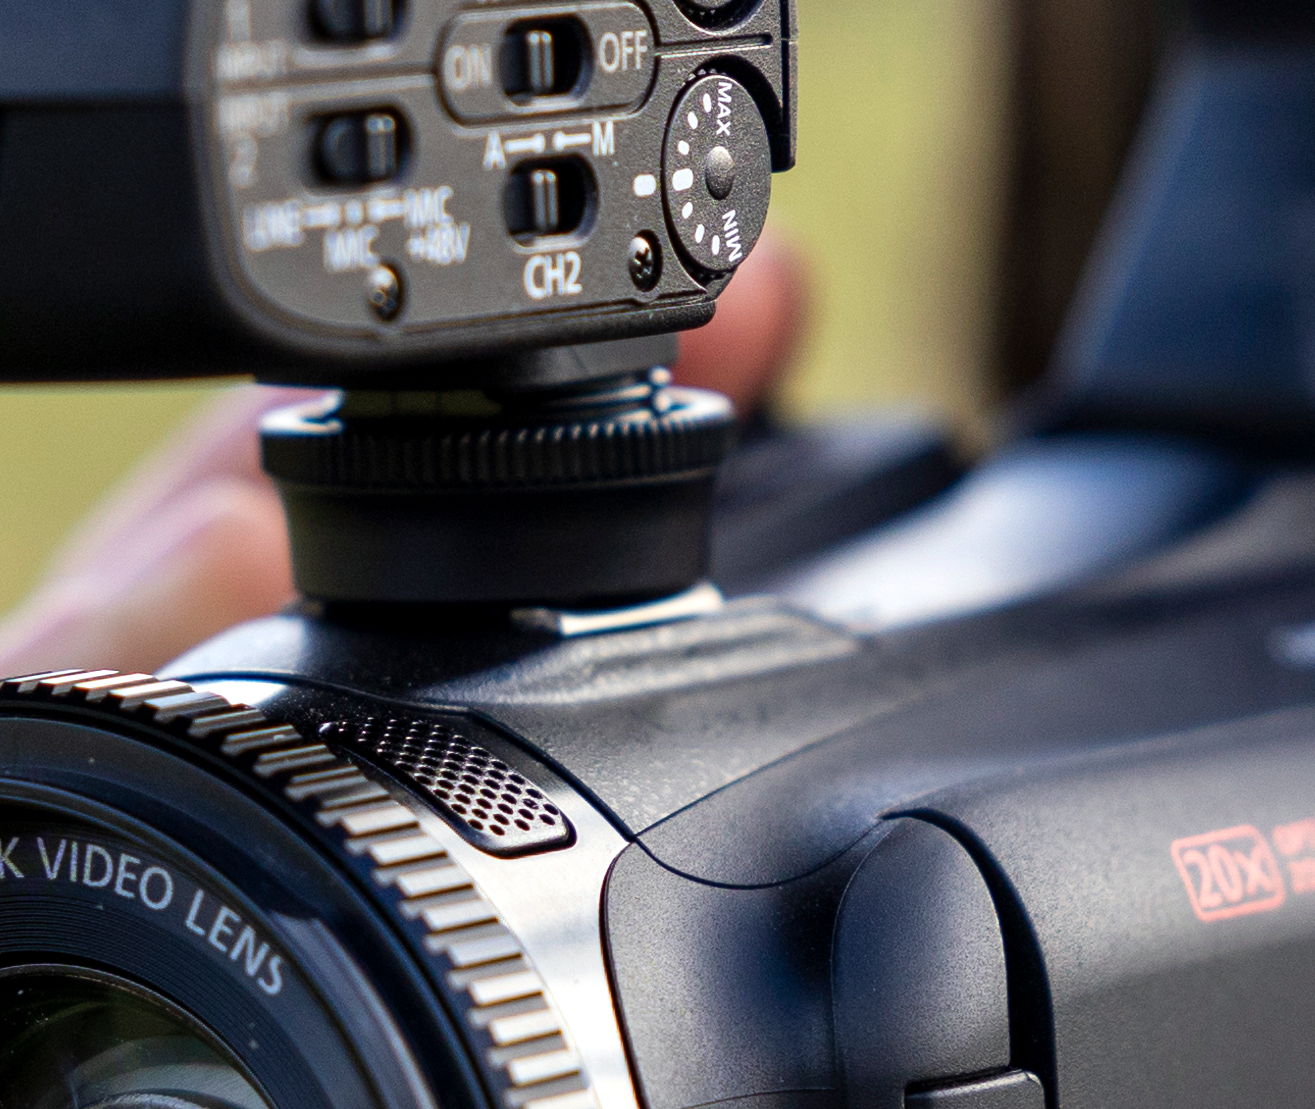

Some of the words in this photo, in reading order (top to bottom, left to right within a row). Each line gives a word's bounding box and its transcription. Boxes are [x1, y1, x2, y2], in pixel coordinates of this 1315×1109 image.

[444, 43, 492, 92] ON
[599, 30, 648, 73] OFF
[717, 81, 733, 136] MAX
[483, 130, 506, 170] A
[592, 120, 615, 156] M
[403, 185, 453, 230] MIC
[323, 223, 380, 273] MIC
[722, 209, 742, 262] MIN
[524, 251, 582, 299] CH2
[36, 837, 174, 911] VIDEO
[185, 890, 285, 997] LENS
